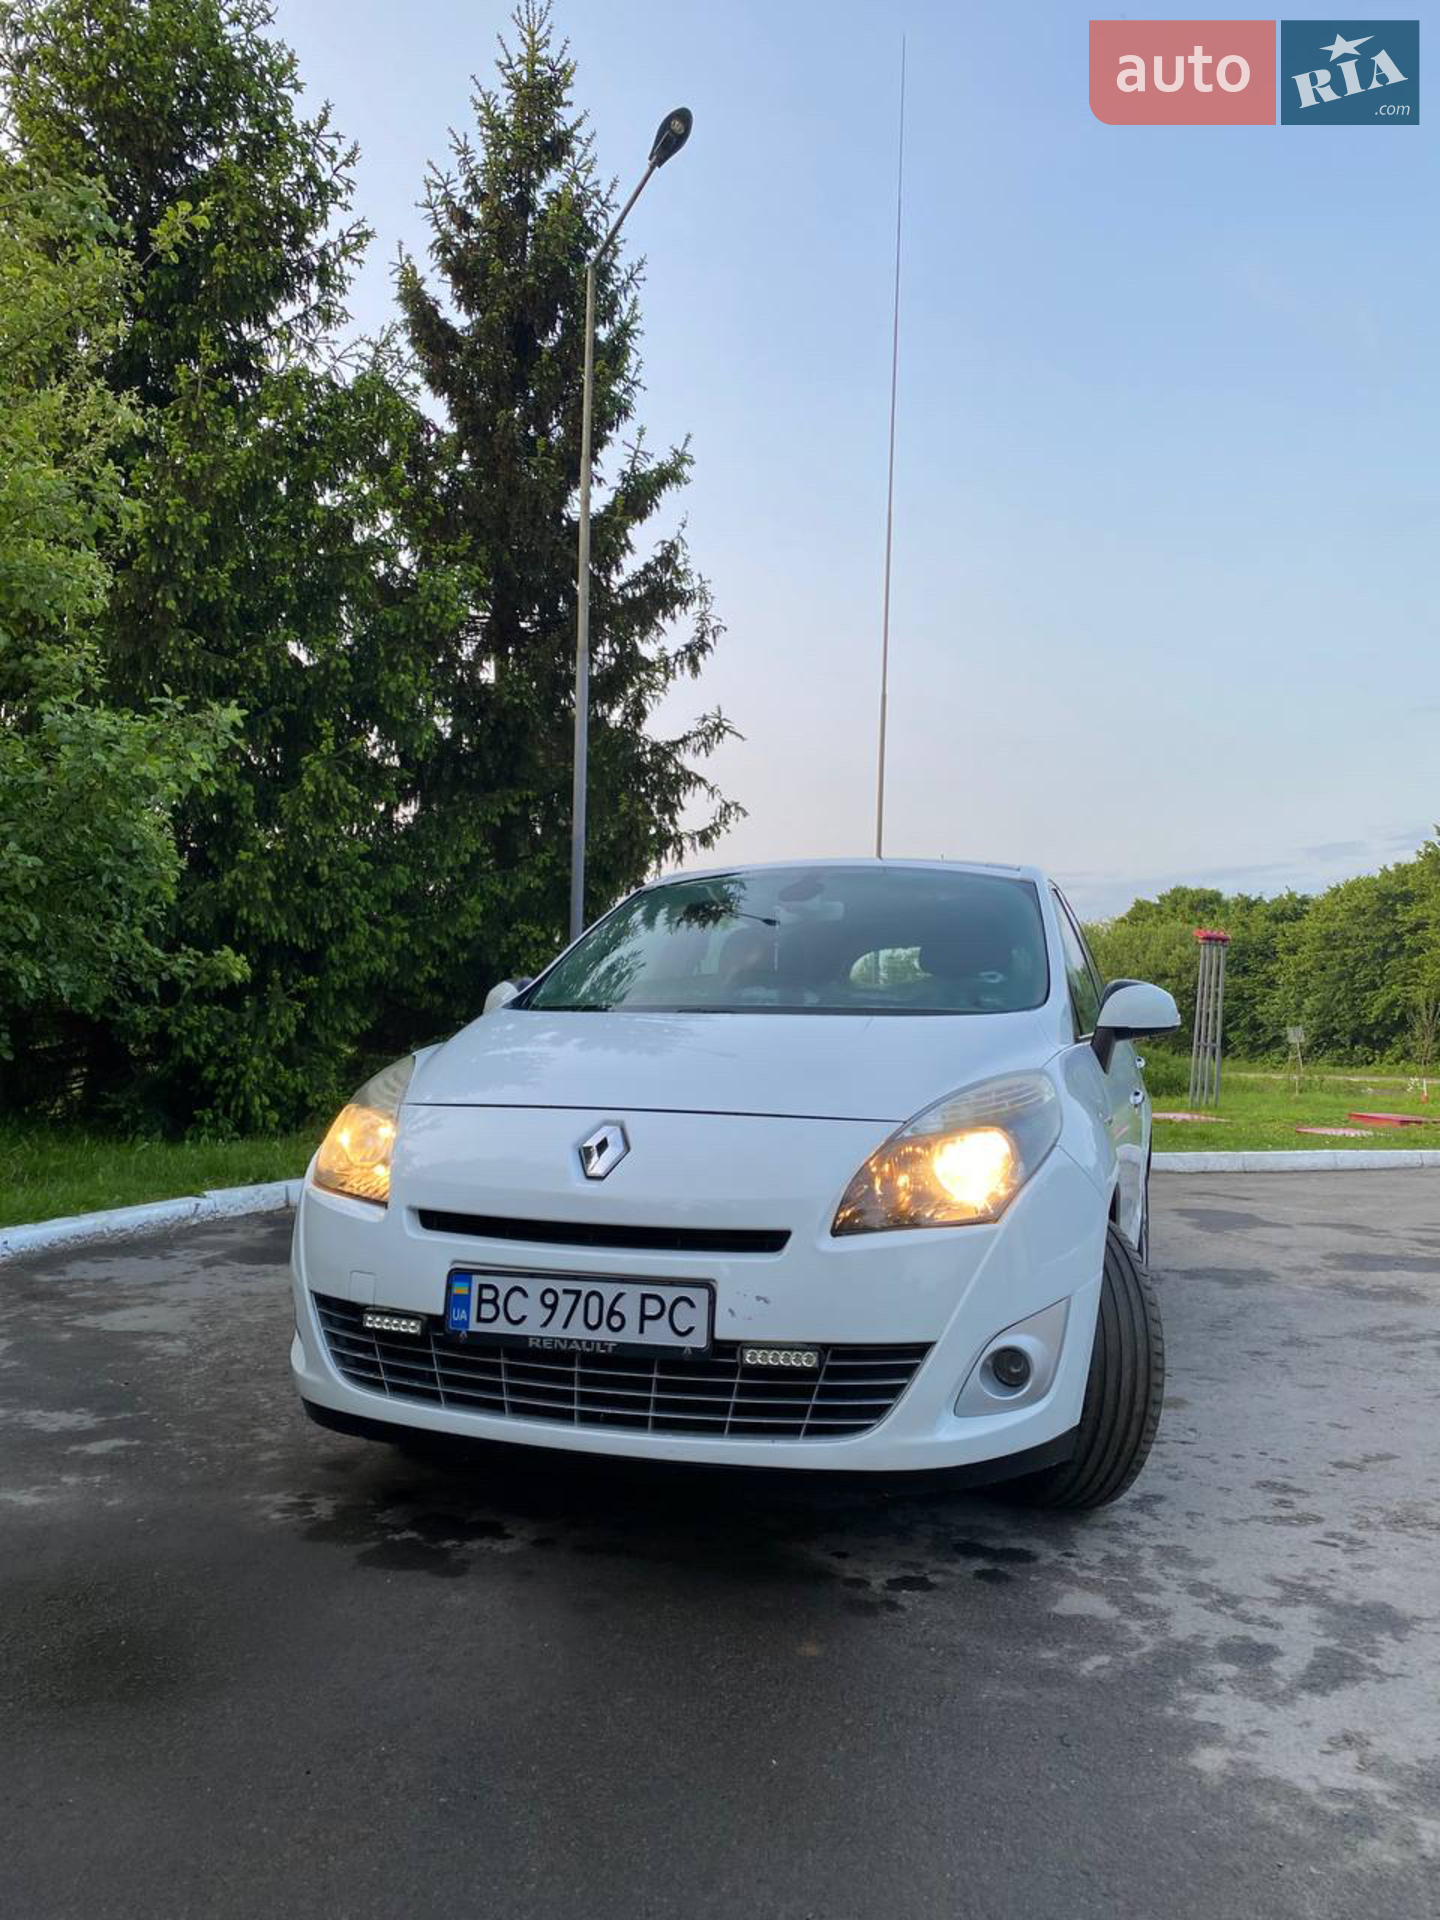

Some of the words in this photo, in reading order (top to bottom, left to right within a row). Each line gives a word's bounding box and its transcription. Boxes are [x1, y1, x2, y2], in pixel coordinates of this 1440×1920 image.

[452, 1307, 468, 1322] UA
[475, 1283, 529, 1326] BC
[539, 1287, 627, 1333] 9706
[638, 1292, 697, 1338] PC
[527, 1336, 619, 1354] RENAULT
